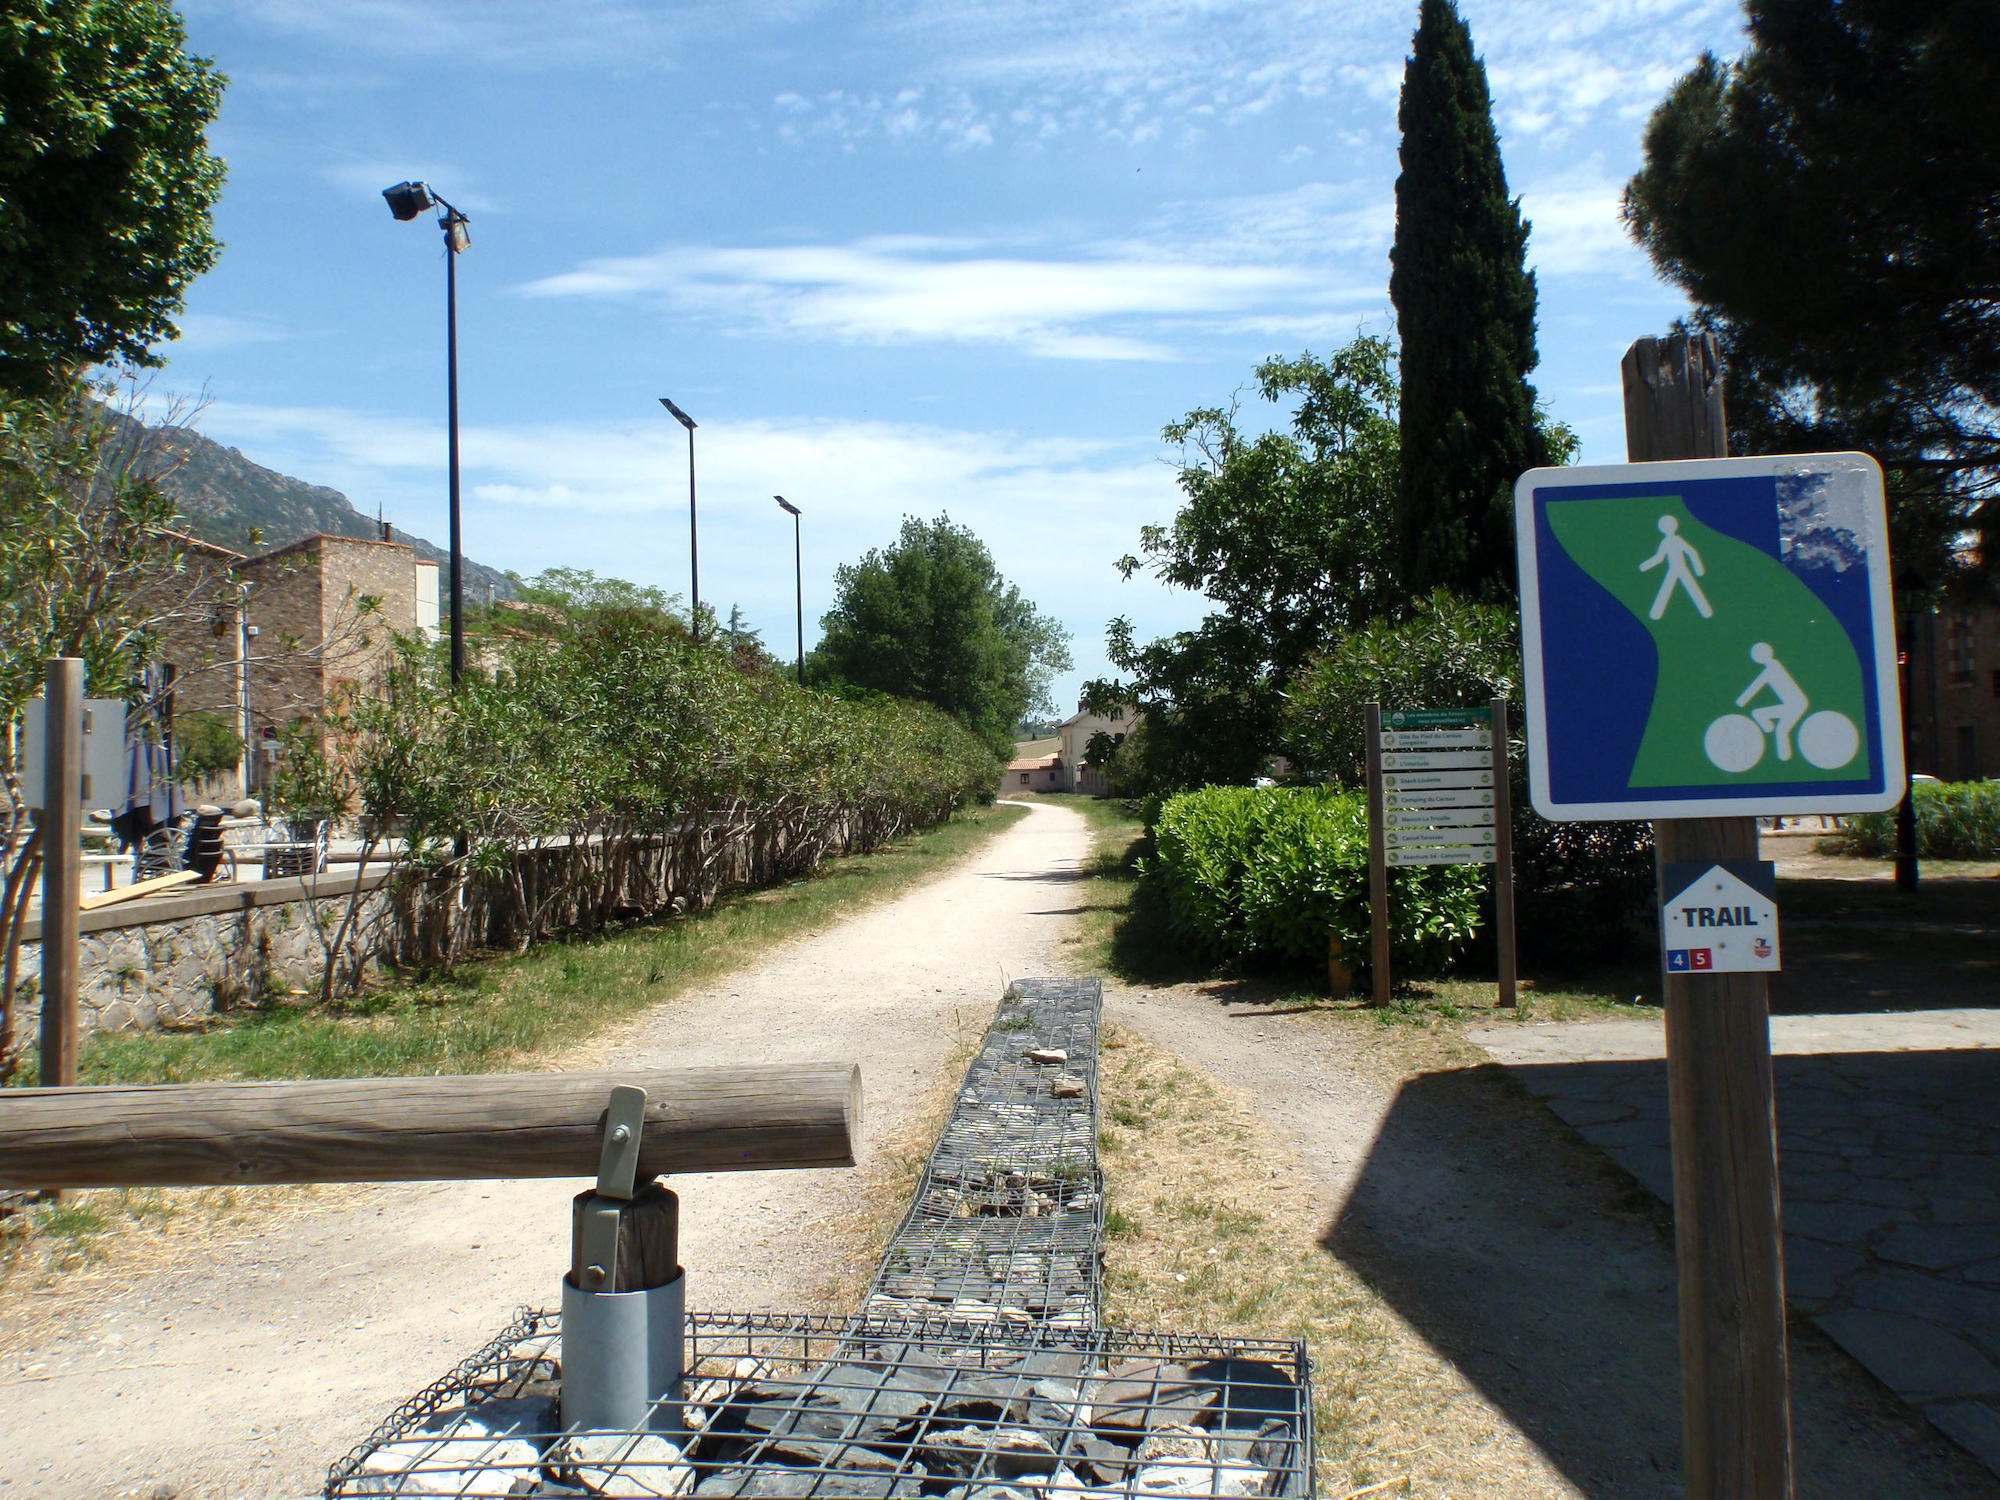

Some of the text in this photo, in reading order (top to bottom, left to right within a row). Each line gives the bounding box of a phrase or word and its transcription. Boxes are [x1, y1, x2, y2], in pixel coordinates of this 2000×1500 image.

[1681, 906, 1759, 928] TRAIL
[1673, 953, 1706, 966] 4 5
